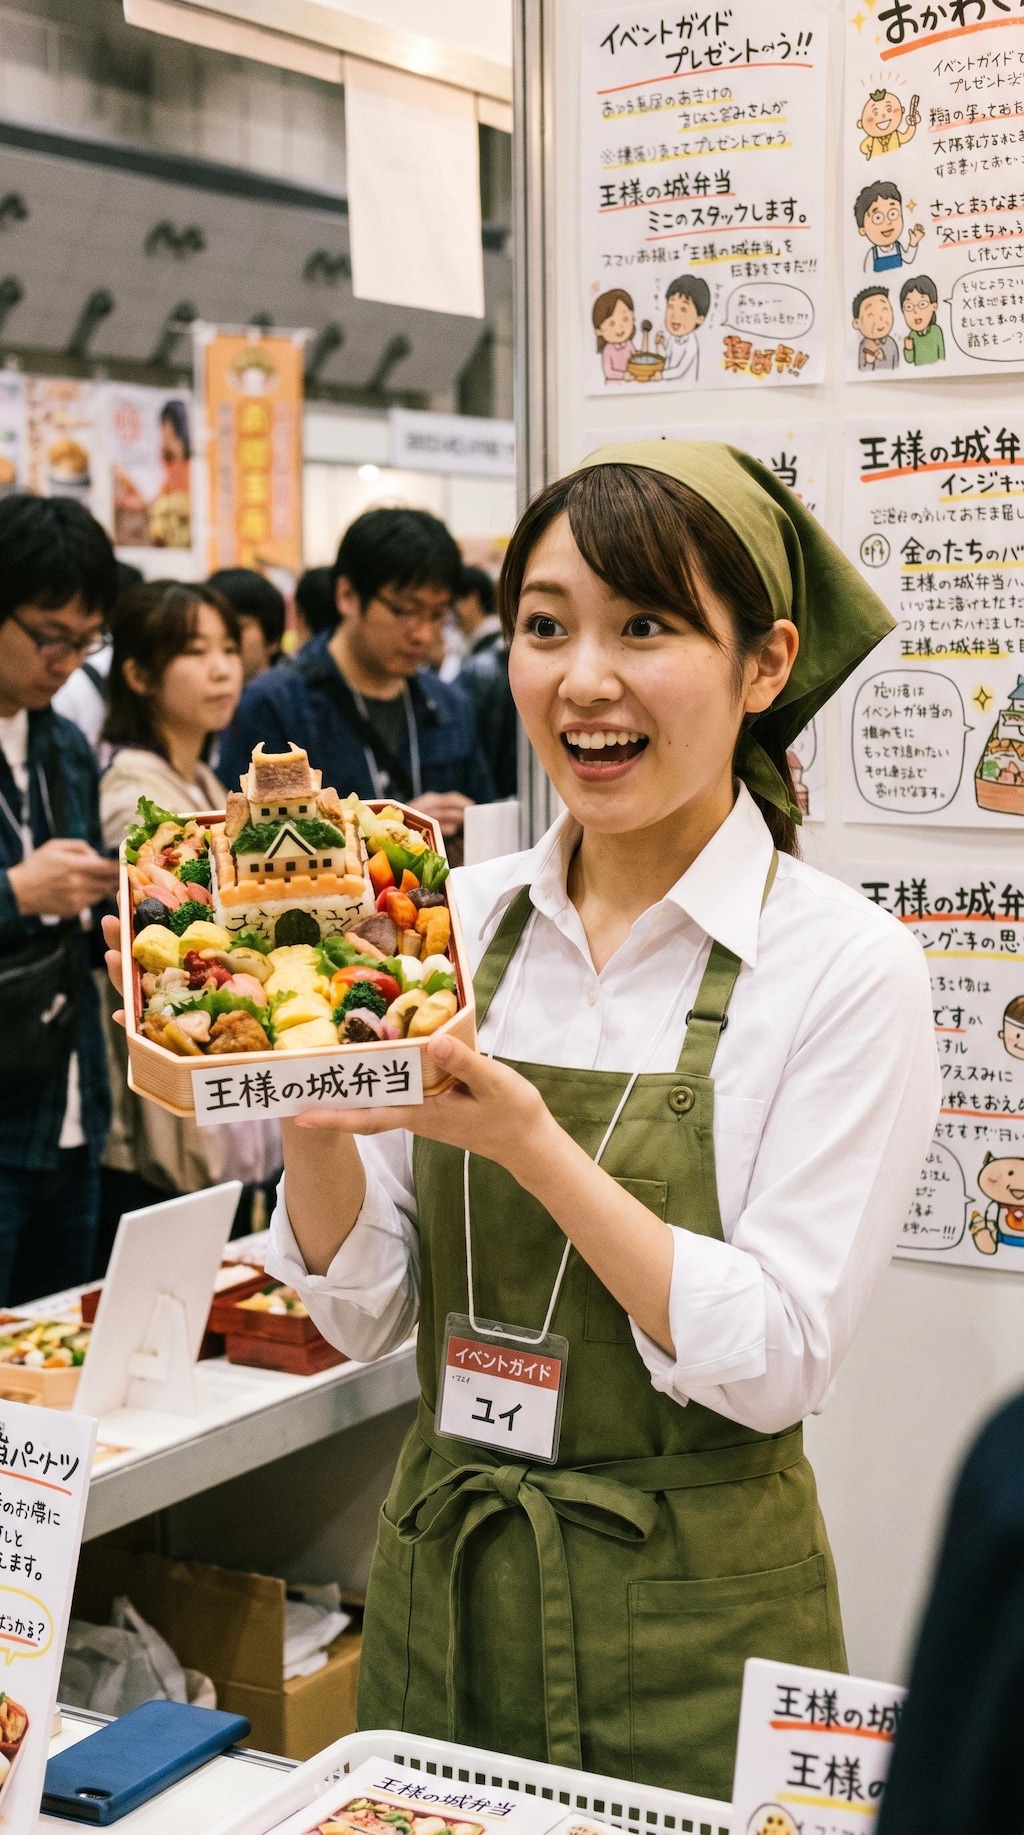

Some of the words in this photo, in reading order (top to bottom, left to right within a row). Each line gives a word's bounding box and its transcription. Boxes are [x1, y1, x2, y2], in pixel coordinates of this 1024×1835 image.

[600, 9, 733, 54] イベントガイド
[599, 168, 731, 207] 王様の城弁当
[859, 425, 1021, 471] 王様の城弁
[204, 1059, 410, 1111] 王様の城弁当
[455, 1347, 552, 1382] イベントガイド
[471, 1396, 523, 1431] ユイ
[0, 1525, 23, 1548] しと
[372, 1776, 516, 1818] 王様の城弁当
